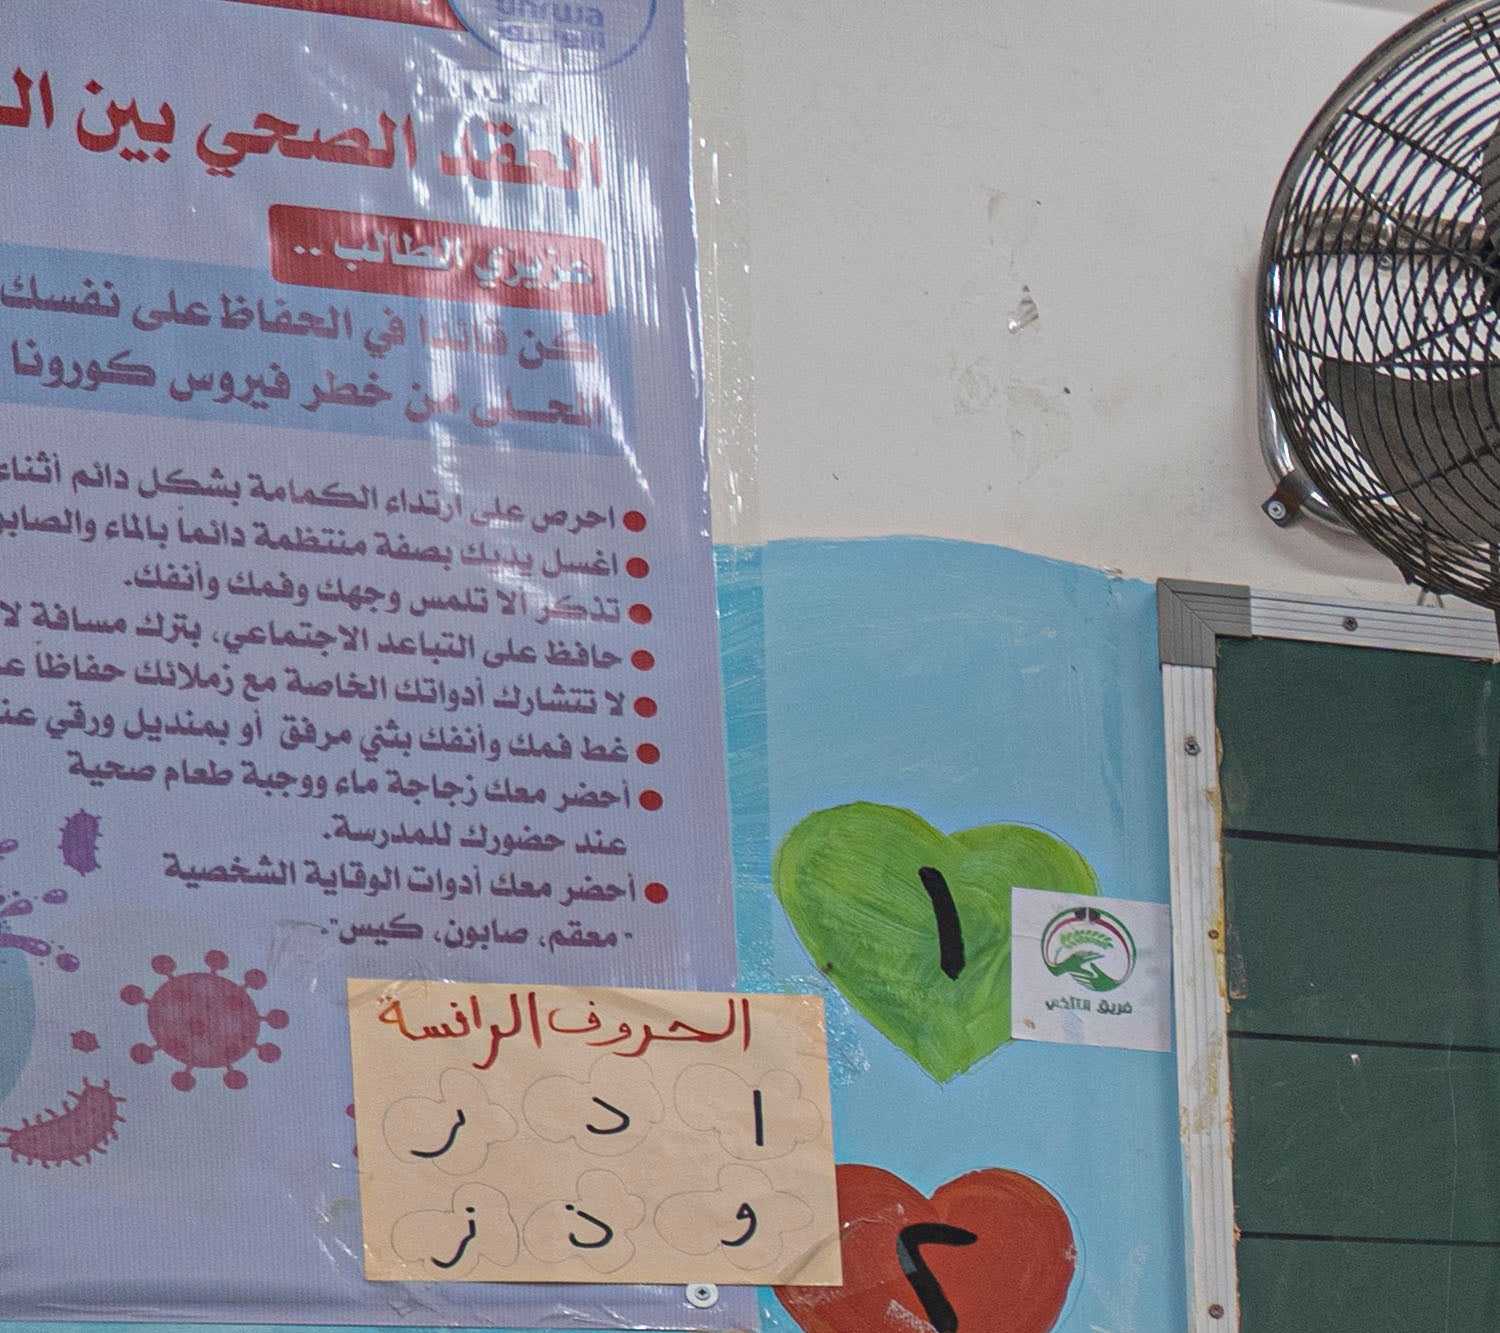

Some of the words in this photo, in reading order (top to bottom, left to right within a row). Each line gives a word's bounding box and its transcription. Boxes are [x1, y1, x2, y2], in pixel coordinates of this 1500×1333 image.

[76, 78, 176, 164] بين
[196, 108, 418, 178] الصحي
[334, 230, 465, 272] الطالب
[473, 244, 595, 292] عزيزي
[0, 275, 121, 318] نفسك
[131, 289, 212, 332] على
[221, 292, 353, 340] الحفاظ
[363, 307, 406, 359] في
[11, 338, 157, 392] كورونا
[518, 328, 597, 370] كن
[169, 361, 291, 410] فيروس
[300, 368, 393, 413] خطر
[404, 382, 460, 424] من
[71, 462, 130, 496] دائم
[137, 466, 242, 507] بشكل
[247, 472, 379, 511] الكمامة
[384, 488, 463, 523] ارتداء
[470, 495, 526, 527] على
[531, 505, 616, 535] احرص
[104, 511, 168, 550] بالماء
[252, 520, 368, 556] منتظمة
[373, 530, 452, 572] بصفة
[541, 549, 619, 579] اغسل
[227, 571, 309, 607] وفمك
[316, 577, 402, 614] وجهك
[409, 586, 489, 617] تلمس
[31, 600, 128, 636] مسافة
[534, 595, 621, 625] تذكر
[135, 612, 202, 650] بترك
[376, 630, 476, 665] التباعد
[482, 637, 537, 669] على
[545, 638, 623, 669] حافظ
[134, 660, 235, 697] زملائك
[242, 671, 278, 702] مع
[284, 667, 388, 701] الخاصة
[394, 676, 485, 713] أدواتك
[492, 682, 598, 717] تتشارك
[604, 689, 626, 717] لا
[45, 699, 116, 740] ورقي
[123, 706, 231, 747] بمنديل
[236, 709, 264, 748] أو
[279, 714, 352, 751] مرفق
[359, 717, 412, 764] بثني
[419, 722, 502, 763] وأنفك
[508, 730, 573, 760] فمك
[580, 735, 629, 763] غط
[67, 749, 157, 788] صحية
[163, 758, 235, 792] طعام
[240, 758, 328, 799] ووجبة
[335, 768, 380, 797] ماء
[384, 768, 479, 808] زجاجة
[484, 777, 548, 805] معك
[552, 779, 631, 813] أحضر
[459, 822, 566, 857] حضورك
[574, 829, 628, 857] عند
[162, 851, 297, 890] الشخصية
[303, 859, 401, 898] الوقاية
[406, 863, 482, 901] أدوات
[489, 871, 553, 899] معك
[558, 871, 637, 907] أحضر
[916, 863, 968, 982] ١
[548, 996, 753, 1059] الحروف
